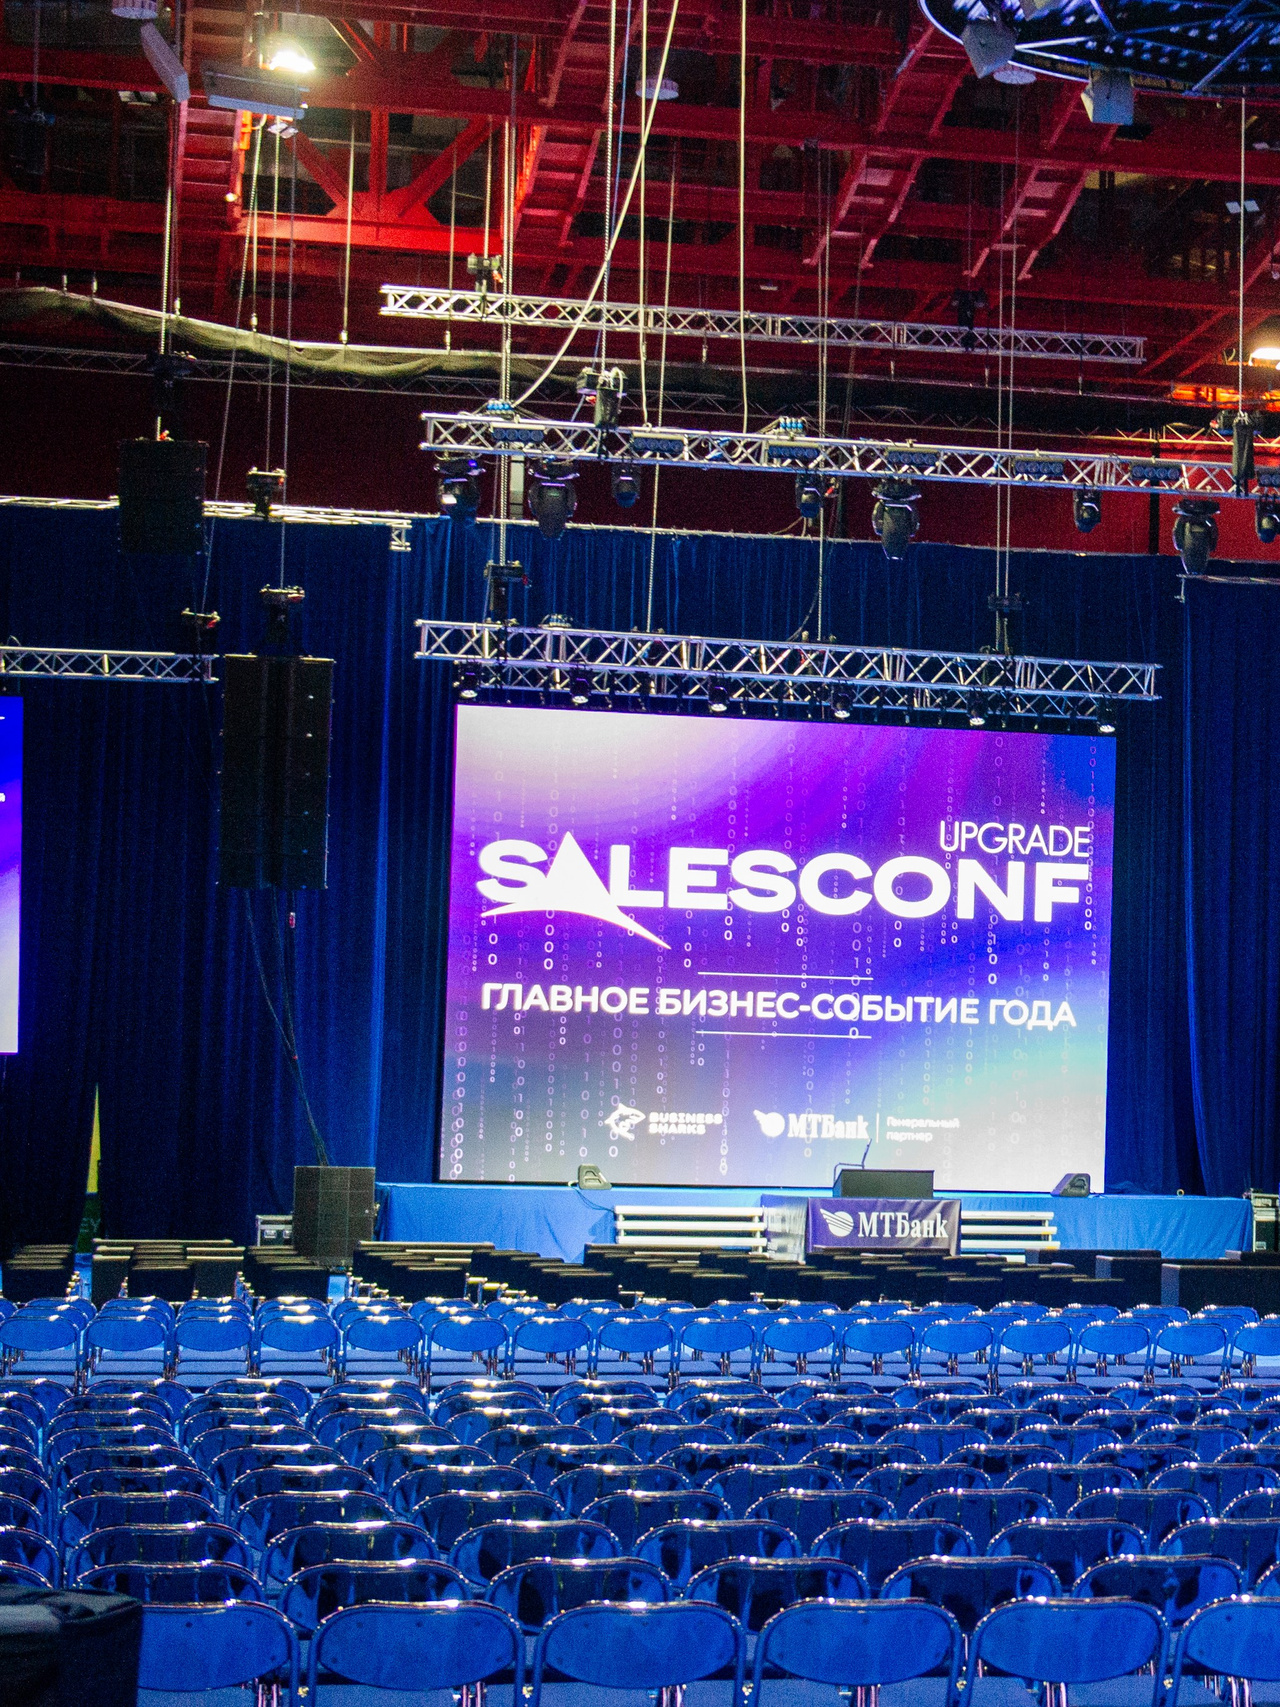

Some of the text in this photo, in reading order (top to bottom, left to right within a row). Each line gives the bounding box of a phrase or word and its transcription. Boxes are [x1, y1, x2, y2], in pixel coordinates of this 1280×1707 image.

[940, 820, 1091, 858] UPGRADE
[475, 831, 1090, 925] SALESCONF
[481, 982, 1077, 1031] ГЛАВНОЕ БИЗНЕС-СОБЫТИЕ ГОДА
[649, 1112, 724, 1125] BUSINESS
[649, 1123, 706, 1135] SHARKS
[857, 1212, 949, 1239] МТБанк
